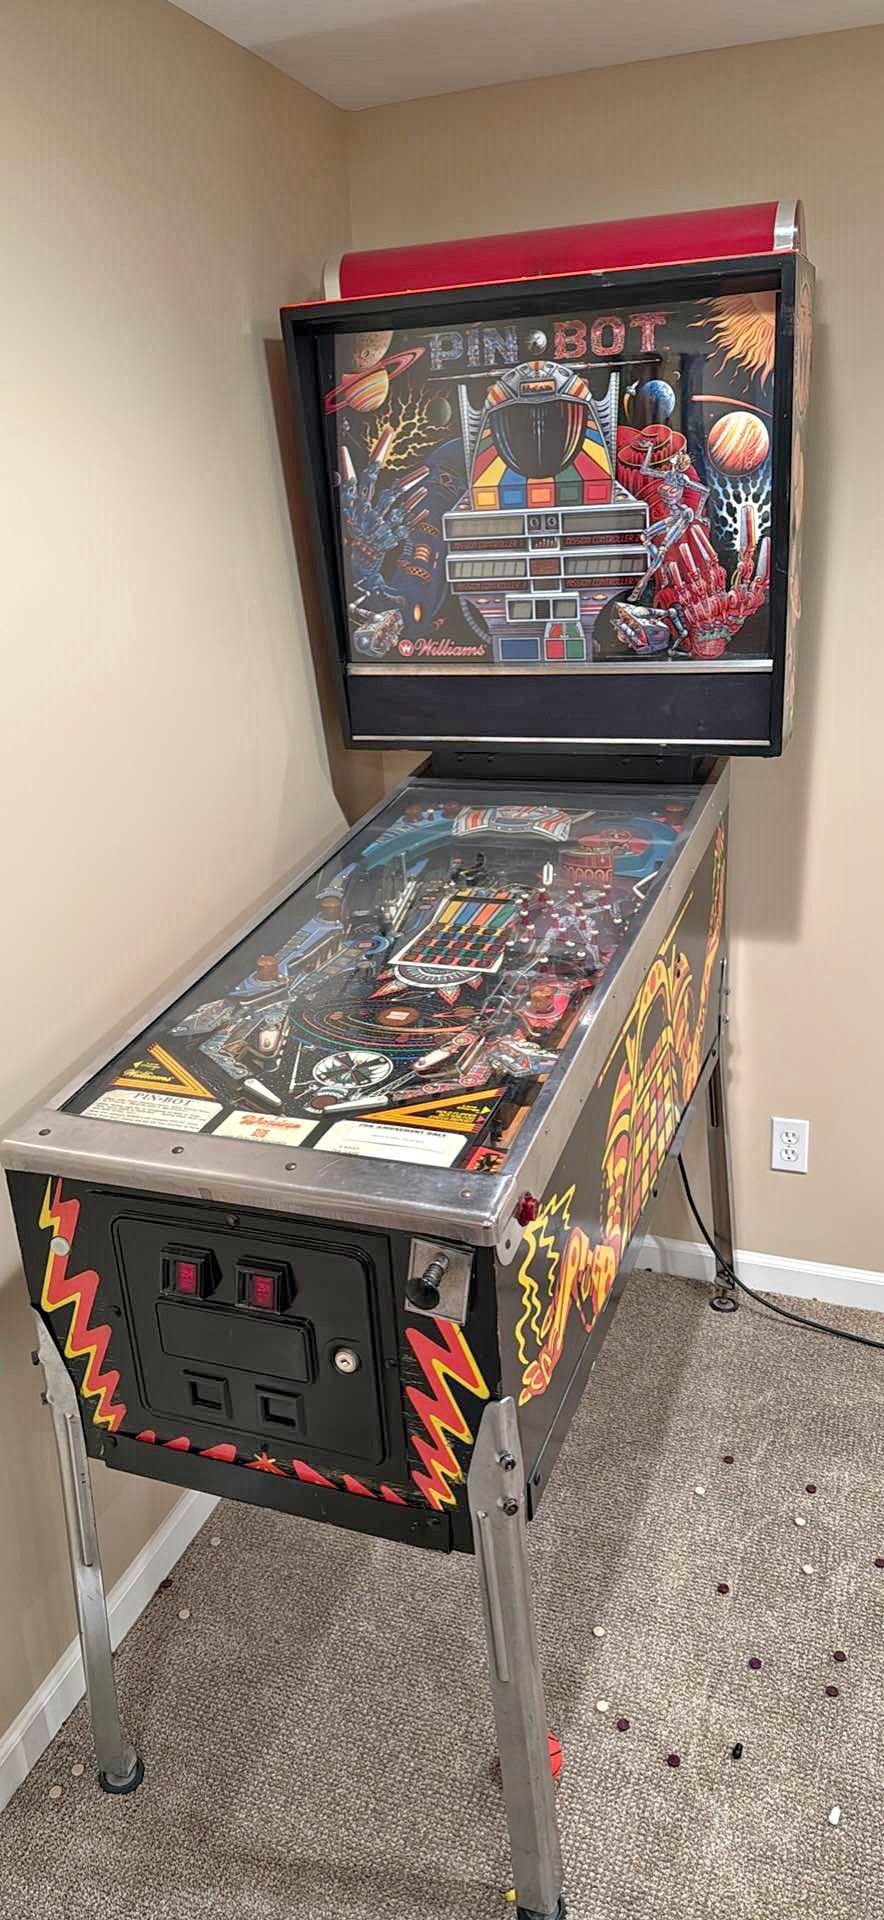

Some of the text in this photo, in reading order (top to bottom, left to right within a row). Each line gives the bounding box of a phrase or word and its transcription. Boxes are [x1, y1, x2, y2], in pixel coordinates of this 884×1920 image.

[429, 312, 667, 370] PIN BOT
[415, 638, 486, 657] Williams
[377, 1124, 425, 1134] AMUSEMENT
